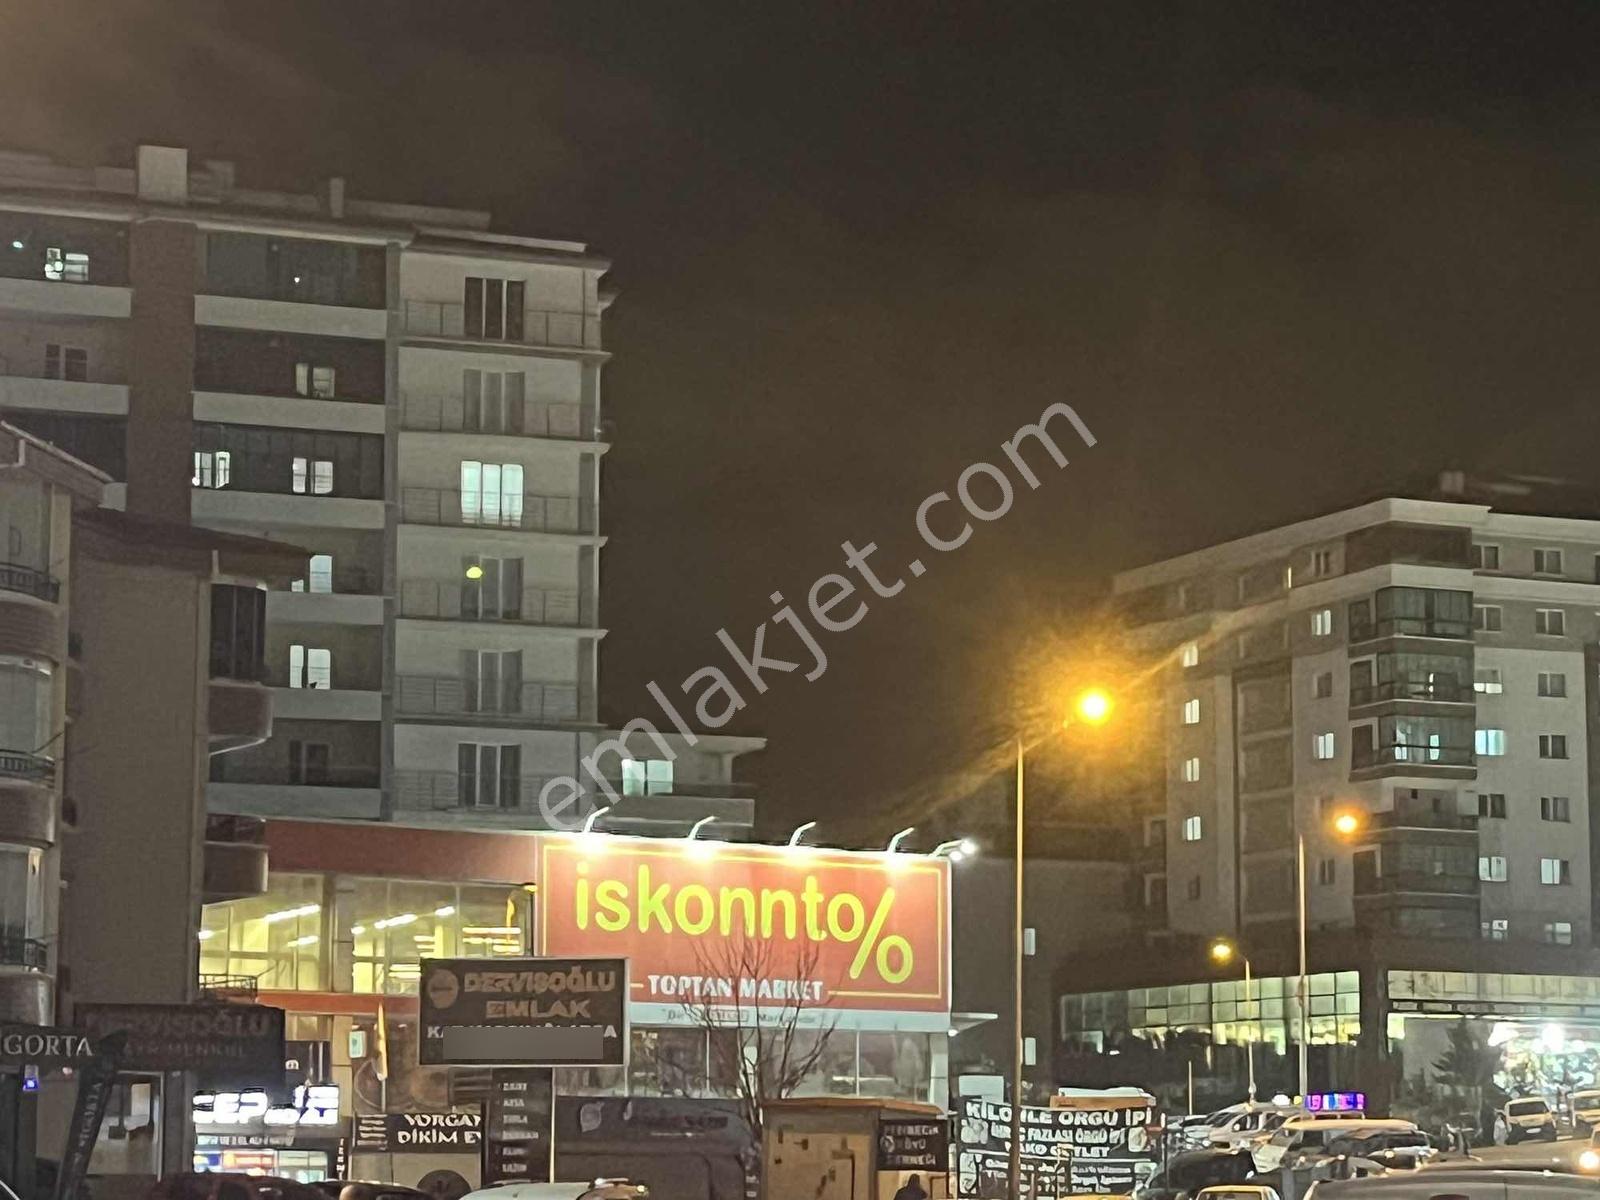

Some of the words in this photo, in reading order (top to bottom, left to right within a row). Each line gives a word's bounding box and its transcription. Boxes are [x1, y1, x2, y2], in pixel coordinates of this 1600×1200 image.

[648, 975, 733, 997] TOPTAN
[739, 977, 823, 1001] MARKET
[485, 999, 591, 1019] EMLAK
[3, 1034, 94, 1057] GORTA
